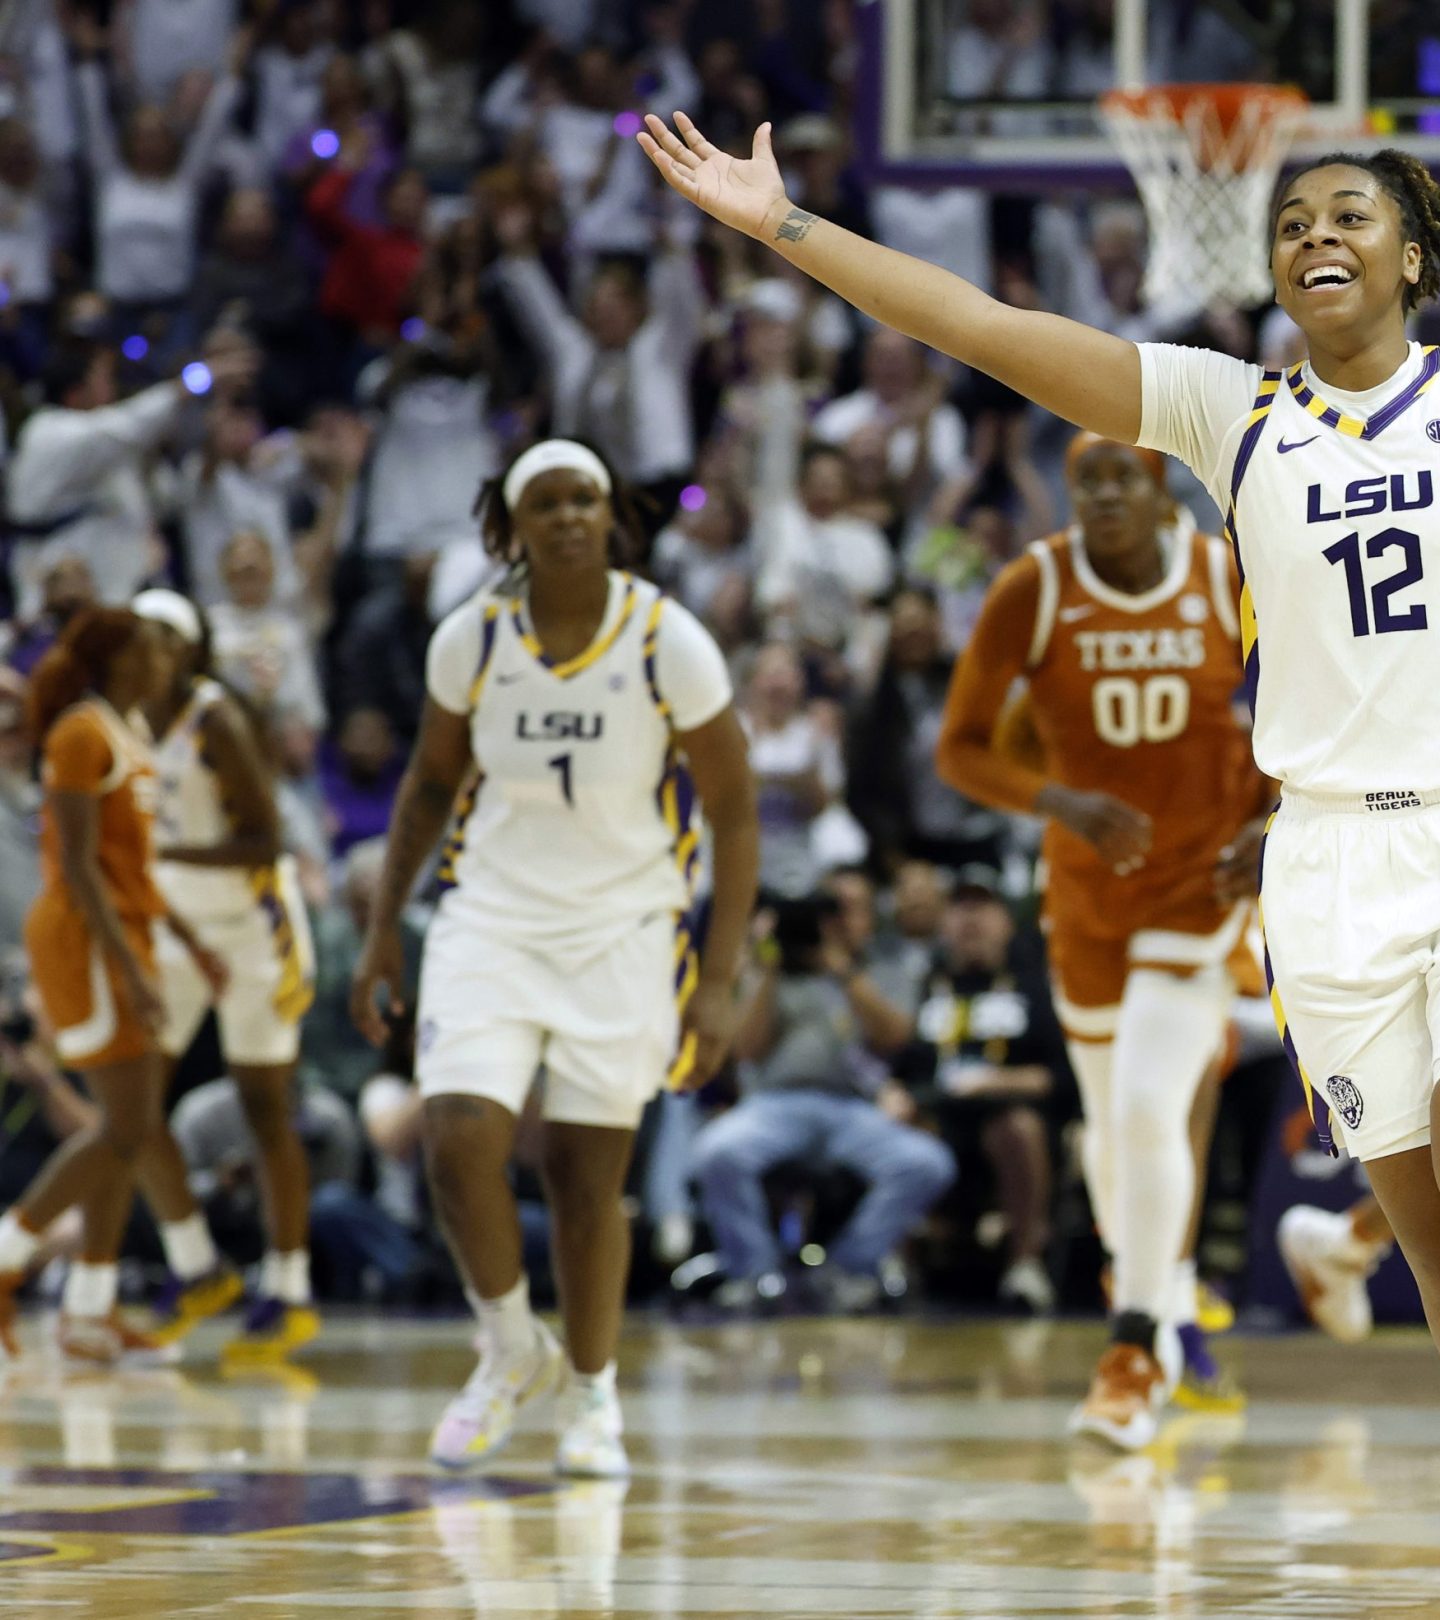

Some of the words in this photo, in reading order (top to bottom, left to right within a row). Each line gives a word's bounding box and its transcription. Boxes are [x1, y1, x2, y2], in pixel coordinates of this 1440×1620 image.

[1307, 470, 1433, 523] LSU
[1321, 527, 1428, 637] 12
[1074, 627, 1206, 672] TEXAS
[516, 711, 604, 741] LSU
[1092, 674, 1190, 747] 00
[548, 751, 574, 812] 1
[1364, 798, 1421, 811] TIGERS
[1365, 790, 1416, 802] GEAUX
